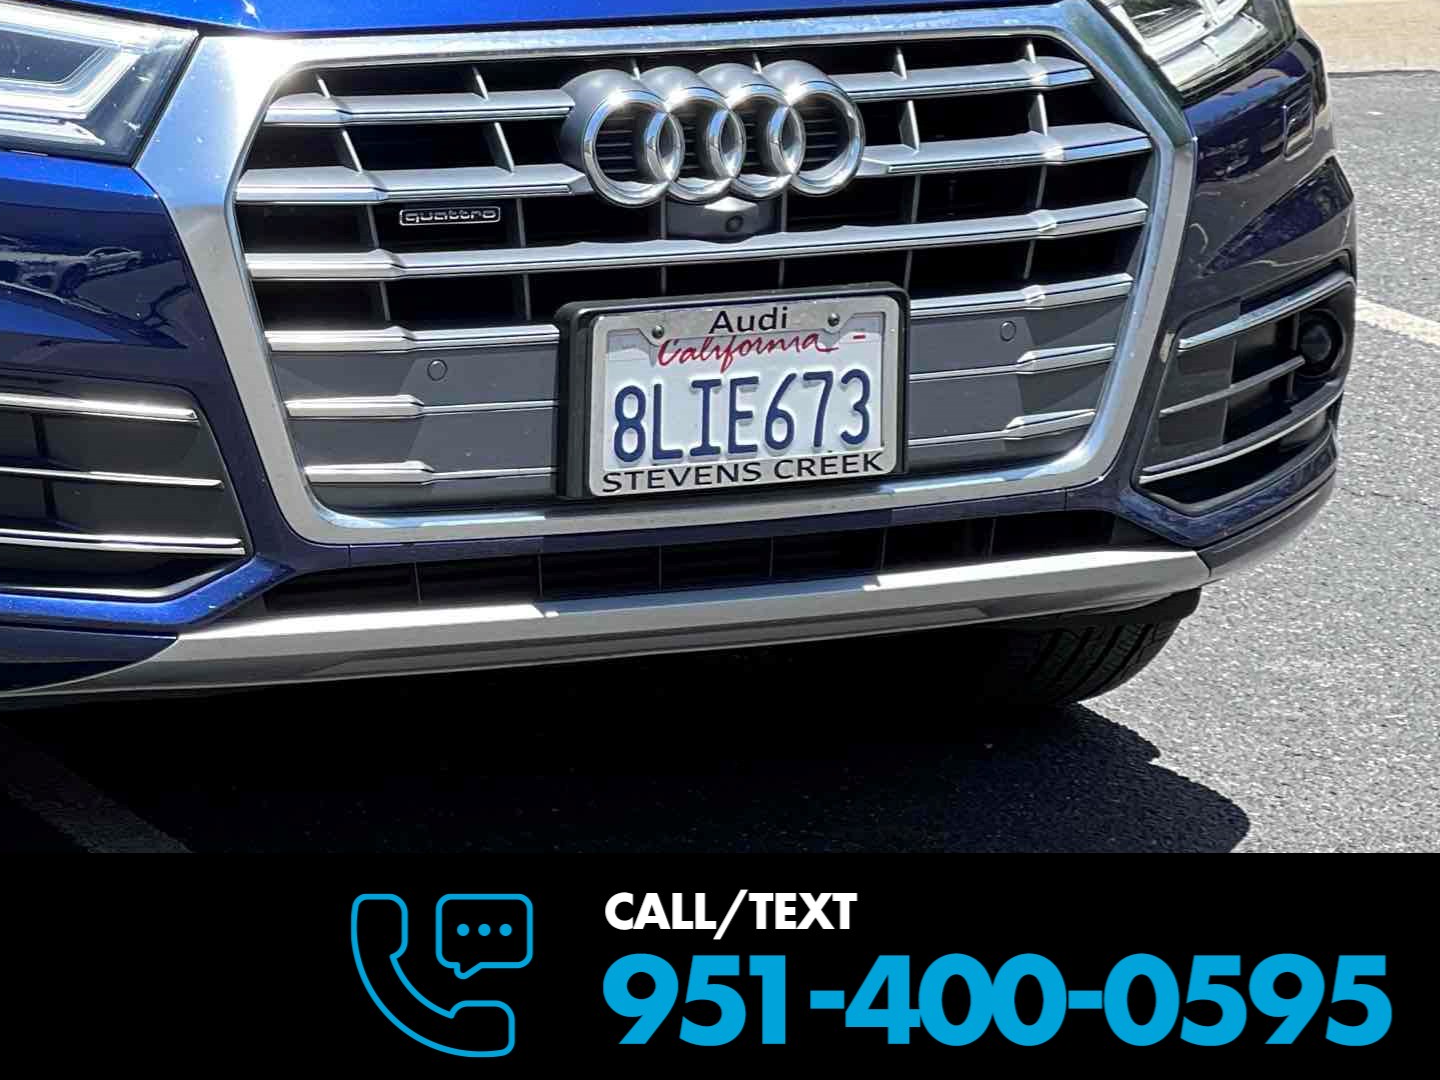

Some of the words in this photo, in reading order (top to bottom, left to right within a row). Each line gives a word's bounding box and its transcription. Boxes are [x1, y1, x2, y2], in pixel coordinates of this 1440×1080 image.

[405, 208, 497, 223] quattro
[708, 306, 789, 335] Audi
[656, 331, 839, 373] California
[613, 368, 871, 463] 8LIE673
[602, 460, 762, 495] STEVENS
[773, 451, 885, 481] CREEK
